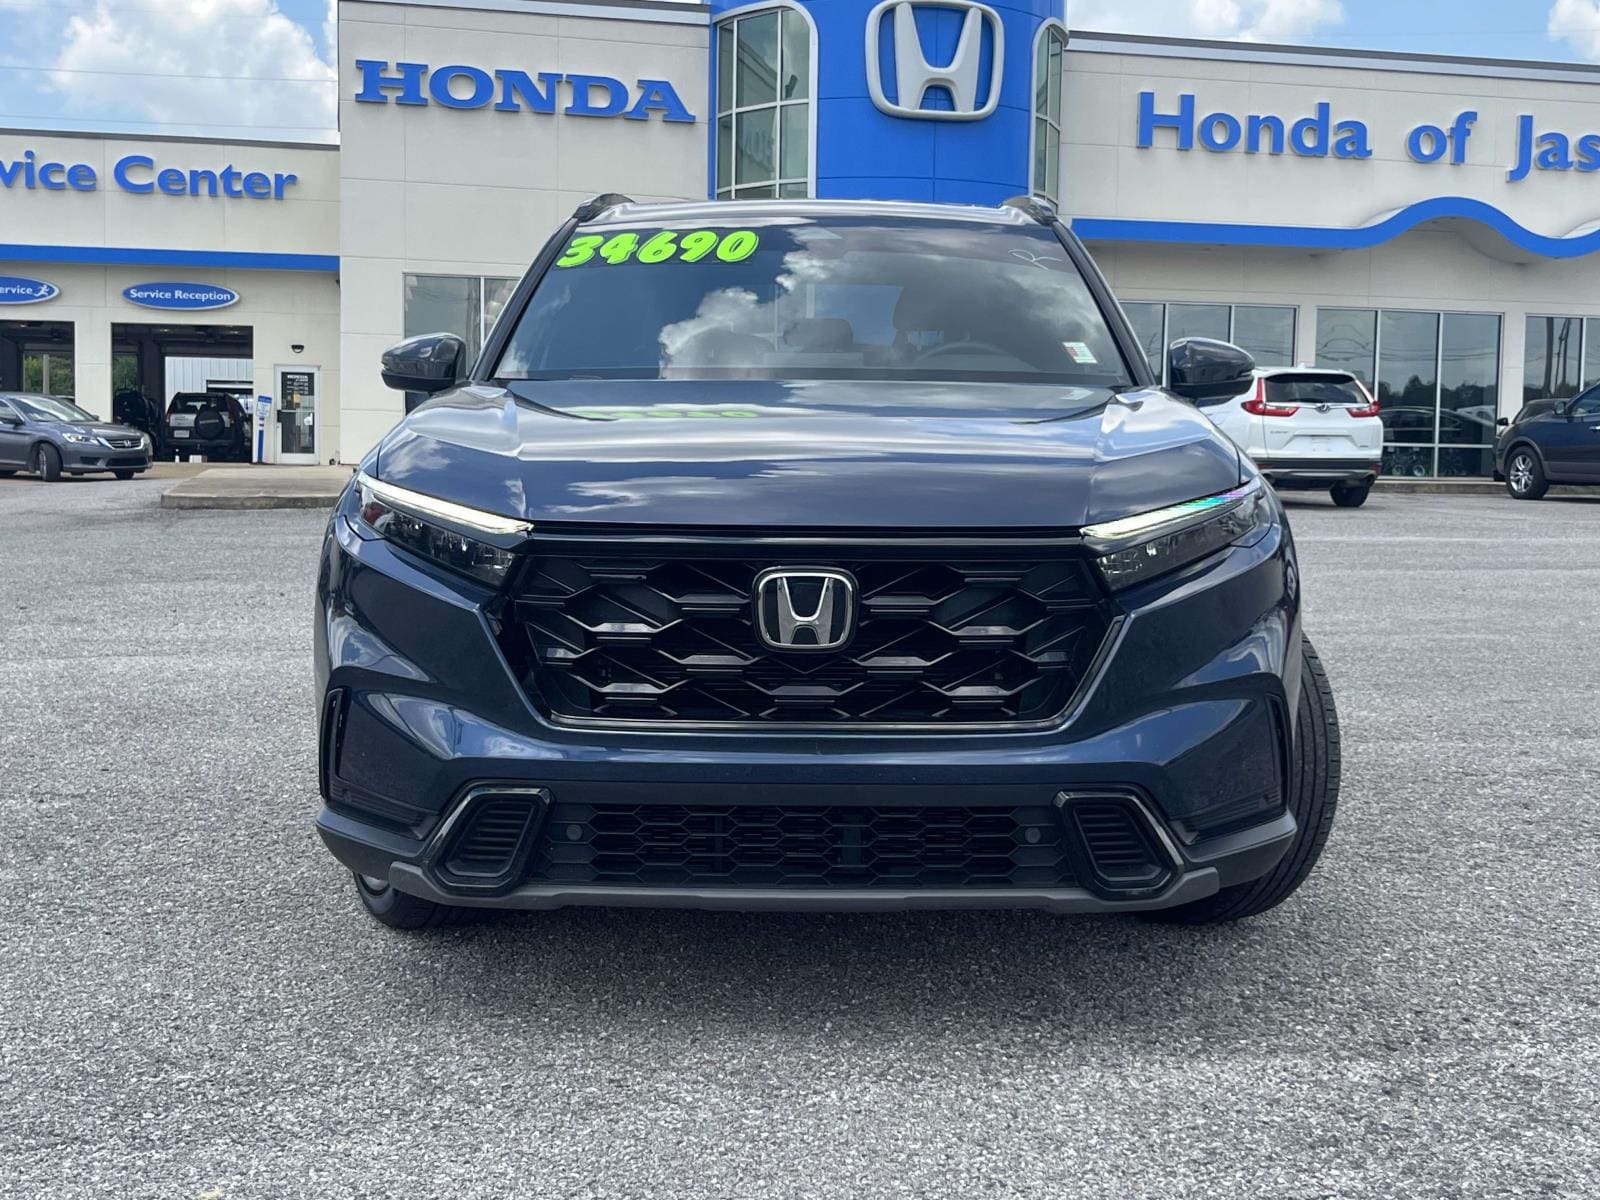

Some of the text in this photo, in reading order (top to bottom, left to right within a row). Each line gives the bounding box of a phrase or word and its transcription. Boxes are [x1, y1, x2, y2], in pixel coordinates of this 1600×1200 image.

[355, 59, 697, 123] HONDA
[1136, 91, 1600, 183] Honda of Jas
[0, 150, 298, 200] vice Center
[556, 230, 759, 267] 34690
[129, 288, 231, 302] Service Reception
